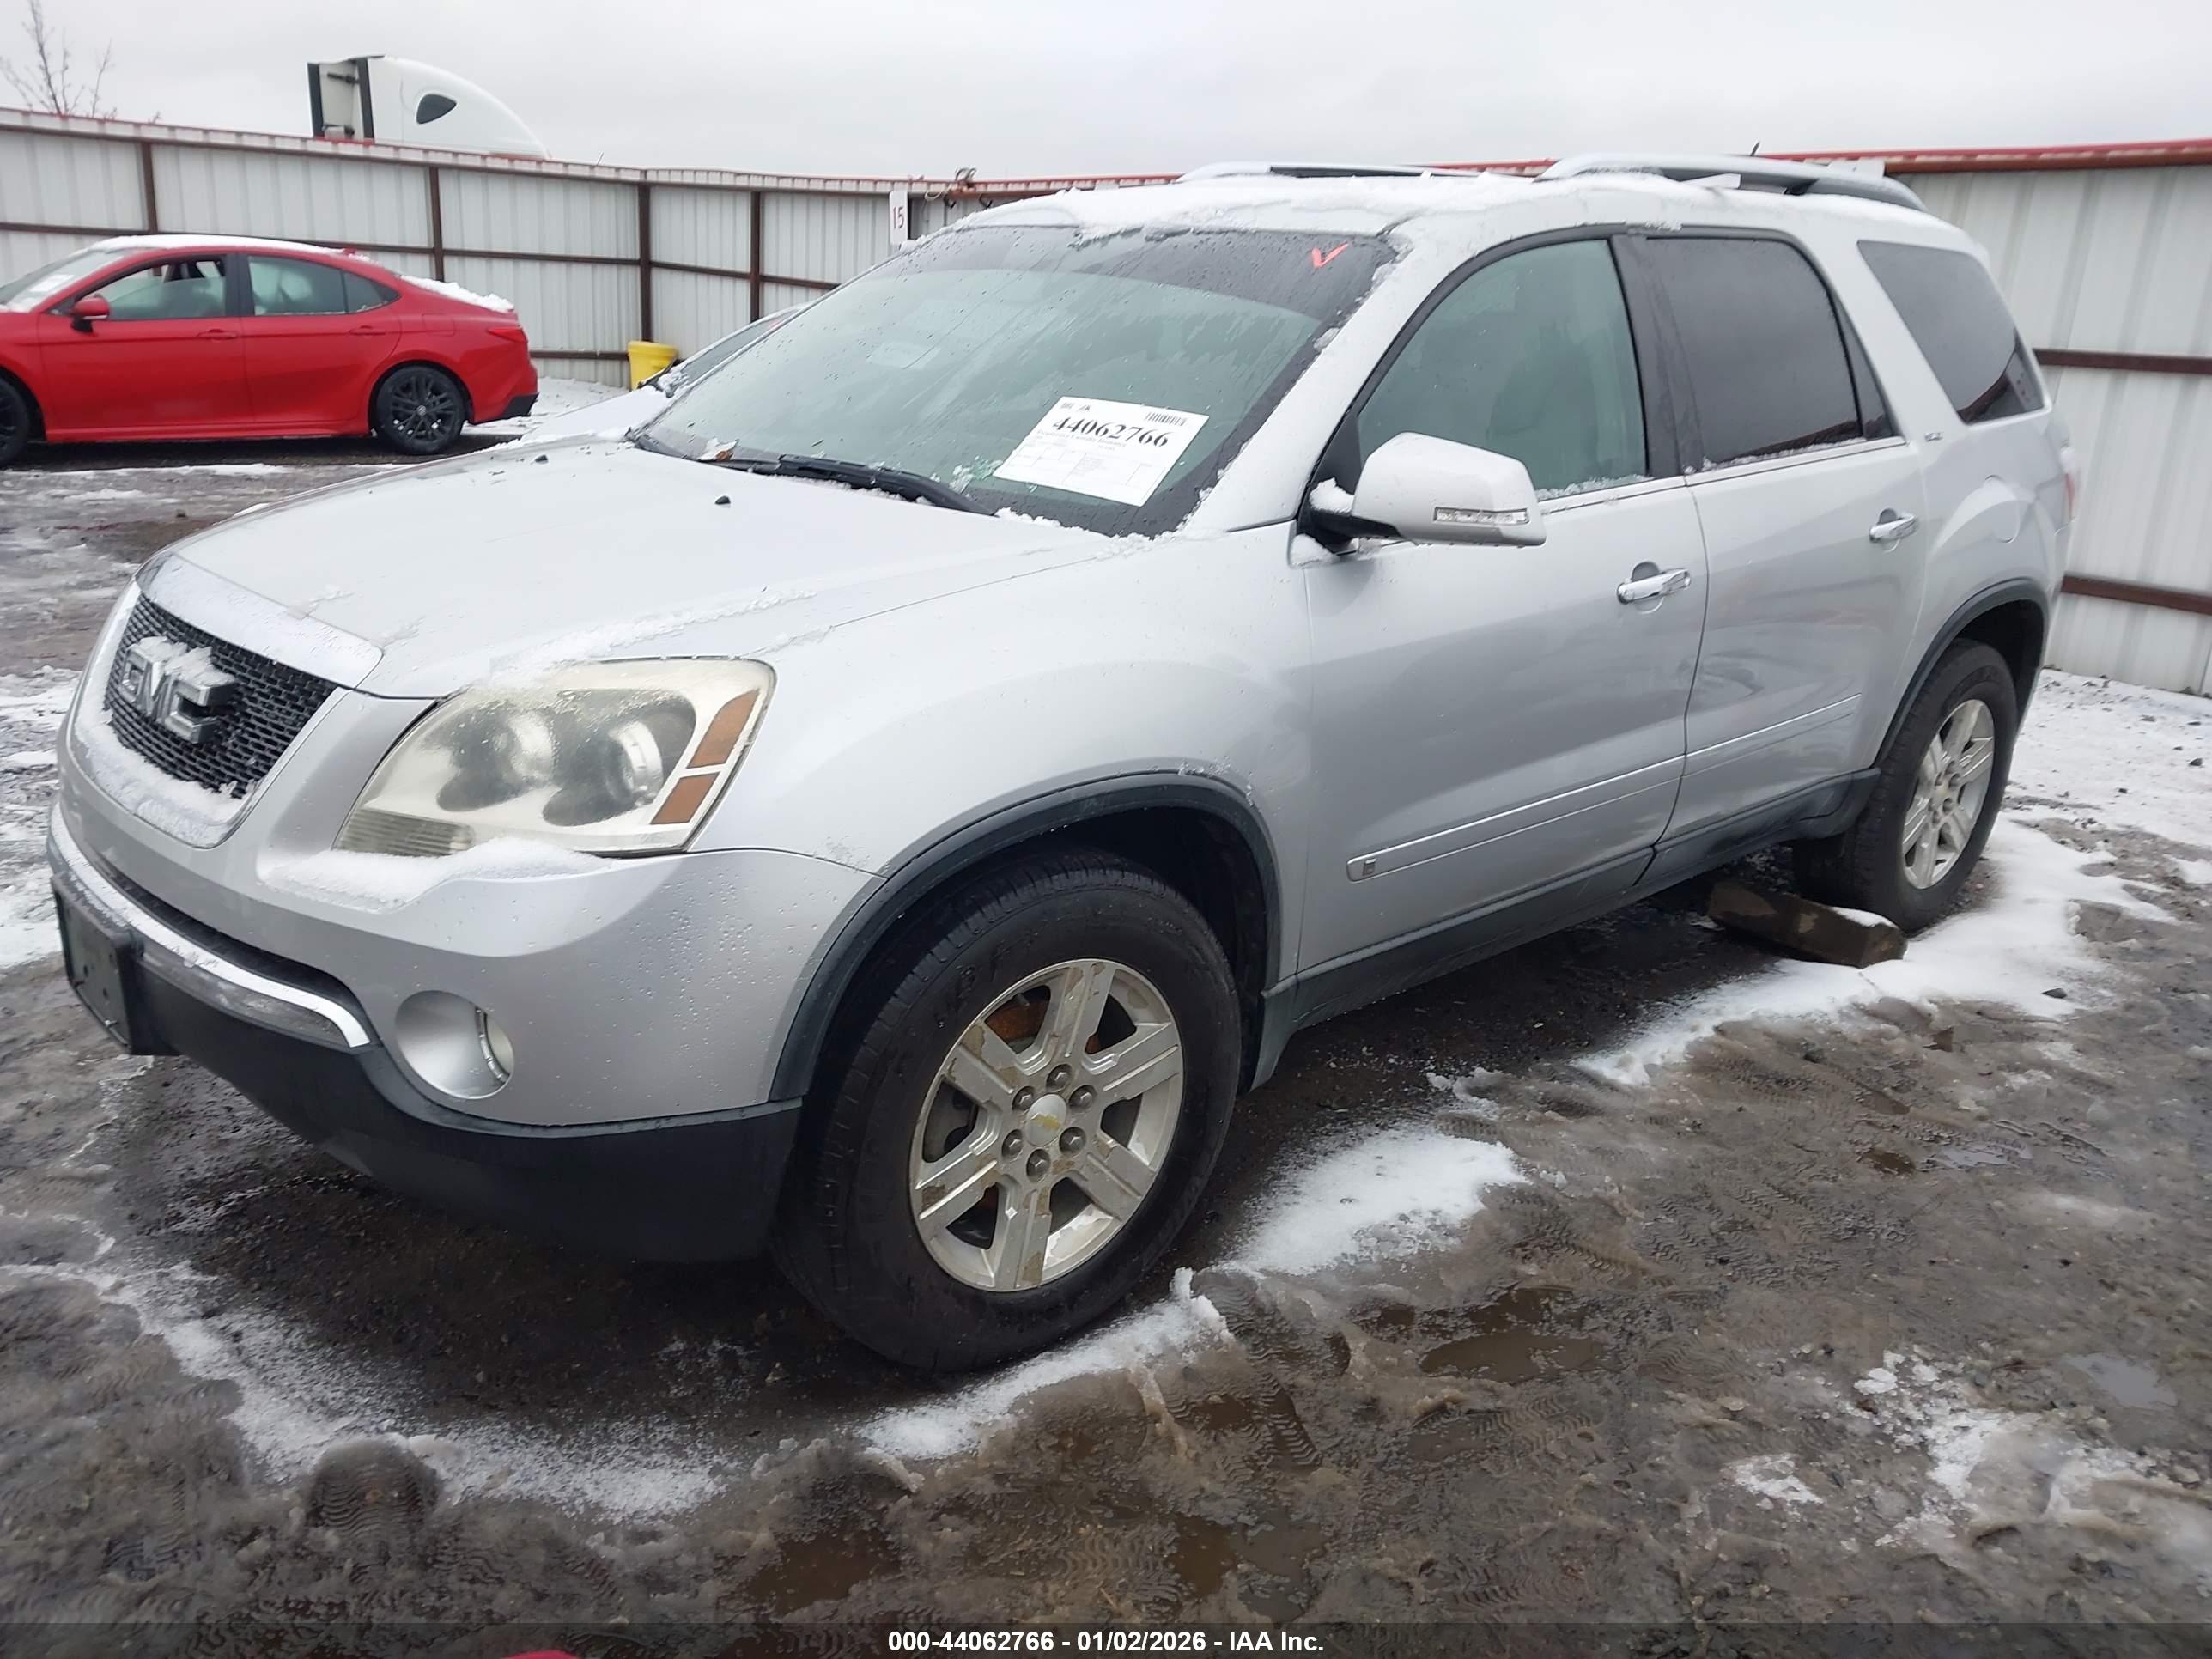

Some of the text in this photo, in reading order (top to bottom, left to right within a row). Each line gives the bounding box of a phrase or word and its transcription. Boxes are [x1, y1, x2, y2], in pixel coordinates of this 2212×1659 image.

[892, 205, 905, 229] 15
[1053, 416, 1173, 447] 44062766
[119, 641, 223, 744] GMC
